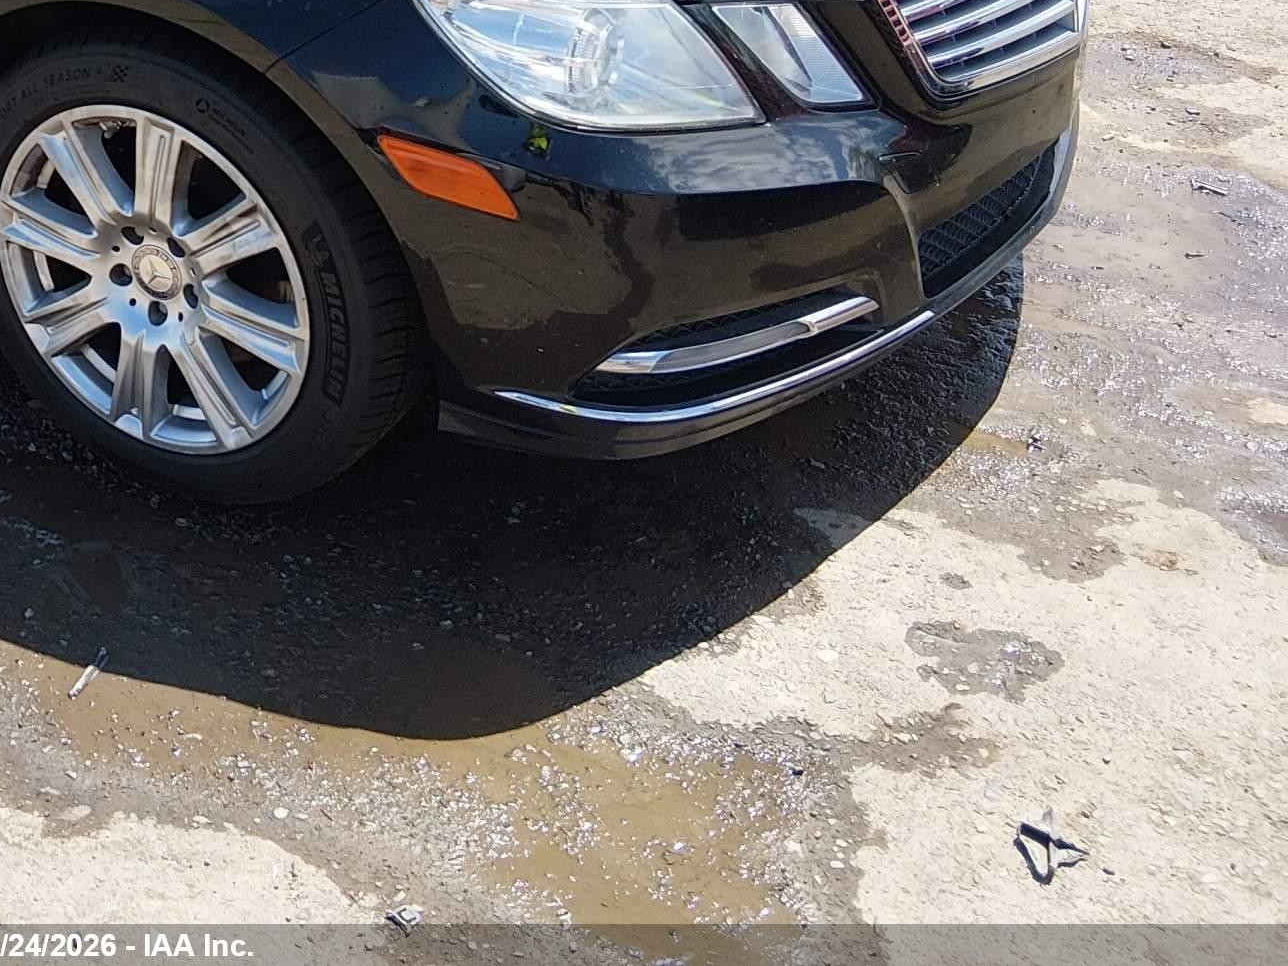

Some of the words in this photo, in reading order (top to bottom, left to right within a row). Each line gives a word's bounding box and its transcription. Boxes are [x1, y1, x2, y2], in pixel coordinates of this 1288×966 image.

[21, 82, 39, 99] ALL
[42, 66, 91, 85] SEASON
[320, 270, 350, 405] MICHELIN
